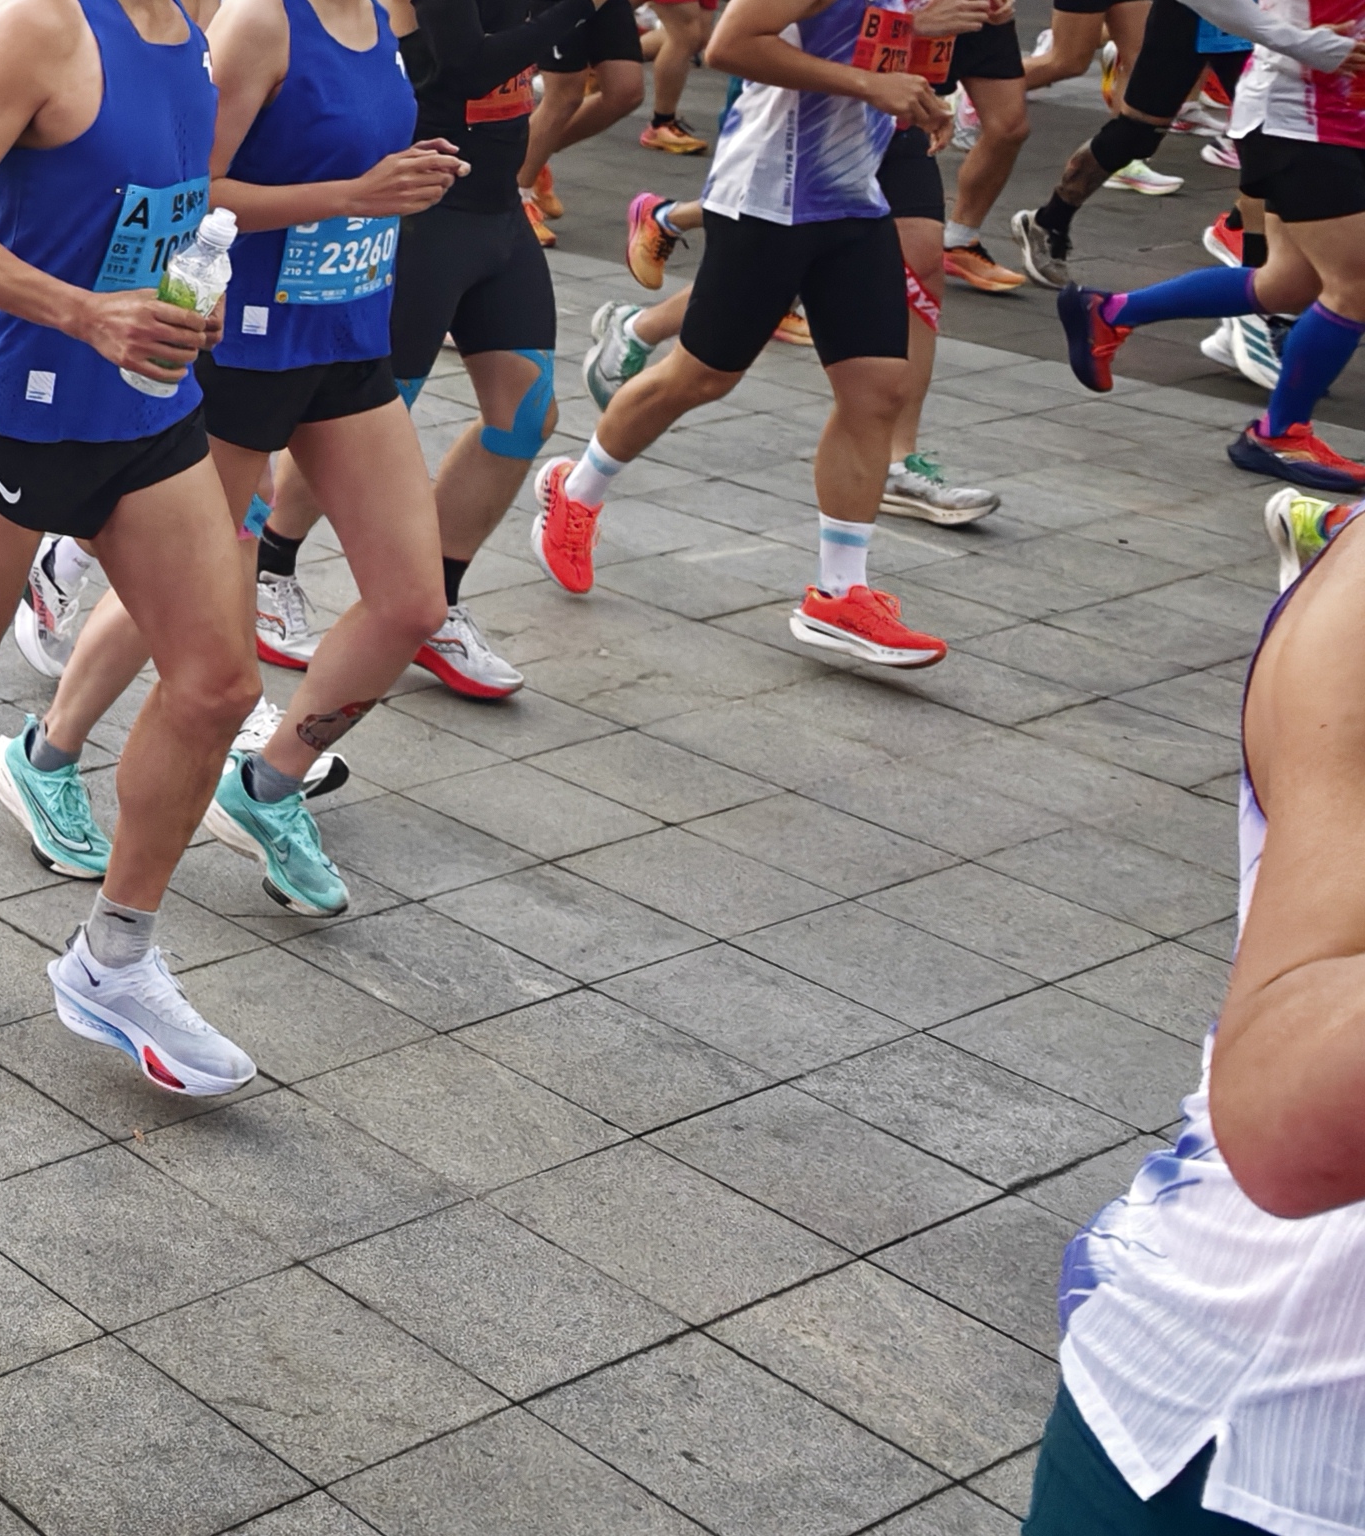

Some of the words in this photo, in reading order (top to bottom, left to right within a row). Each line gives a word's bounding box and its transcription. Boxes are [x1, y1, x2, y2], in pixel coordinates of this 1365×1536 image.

[864, 13, 881, 39] B
[123, 197, 150, 229] A
[288, 247, 303, 258] 17
[318, 227, 395, 276] 23260
